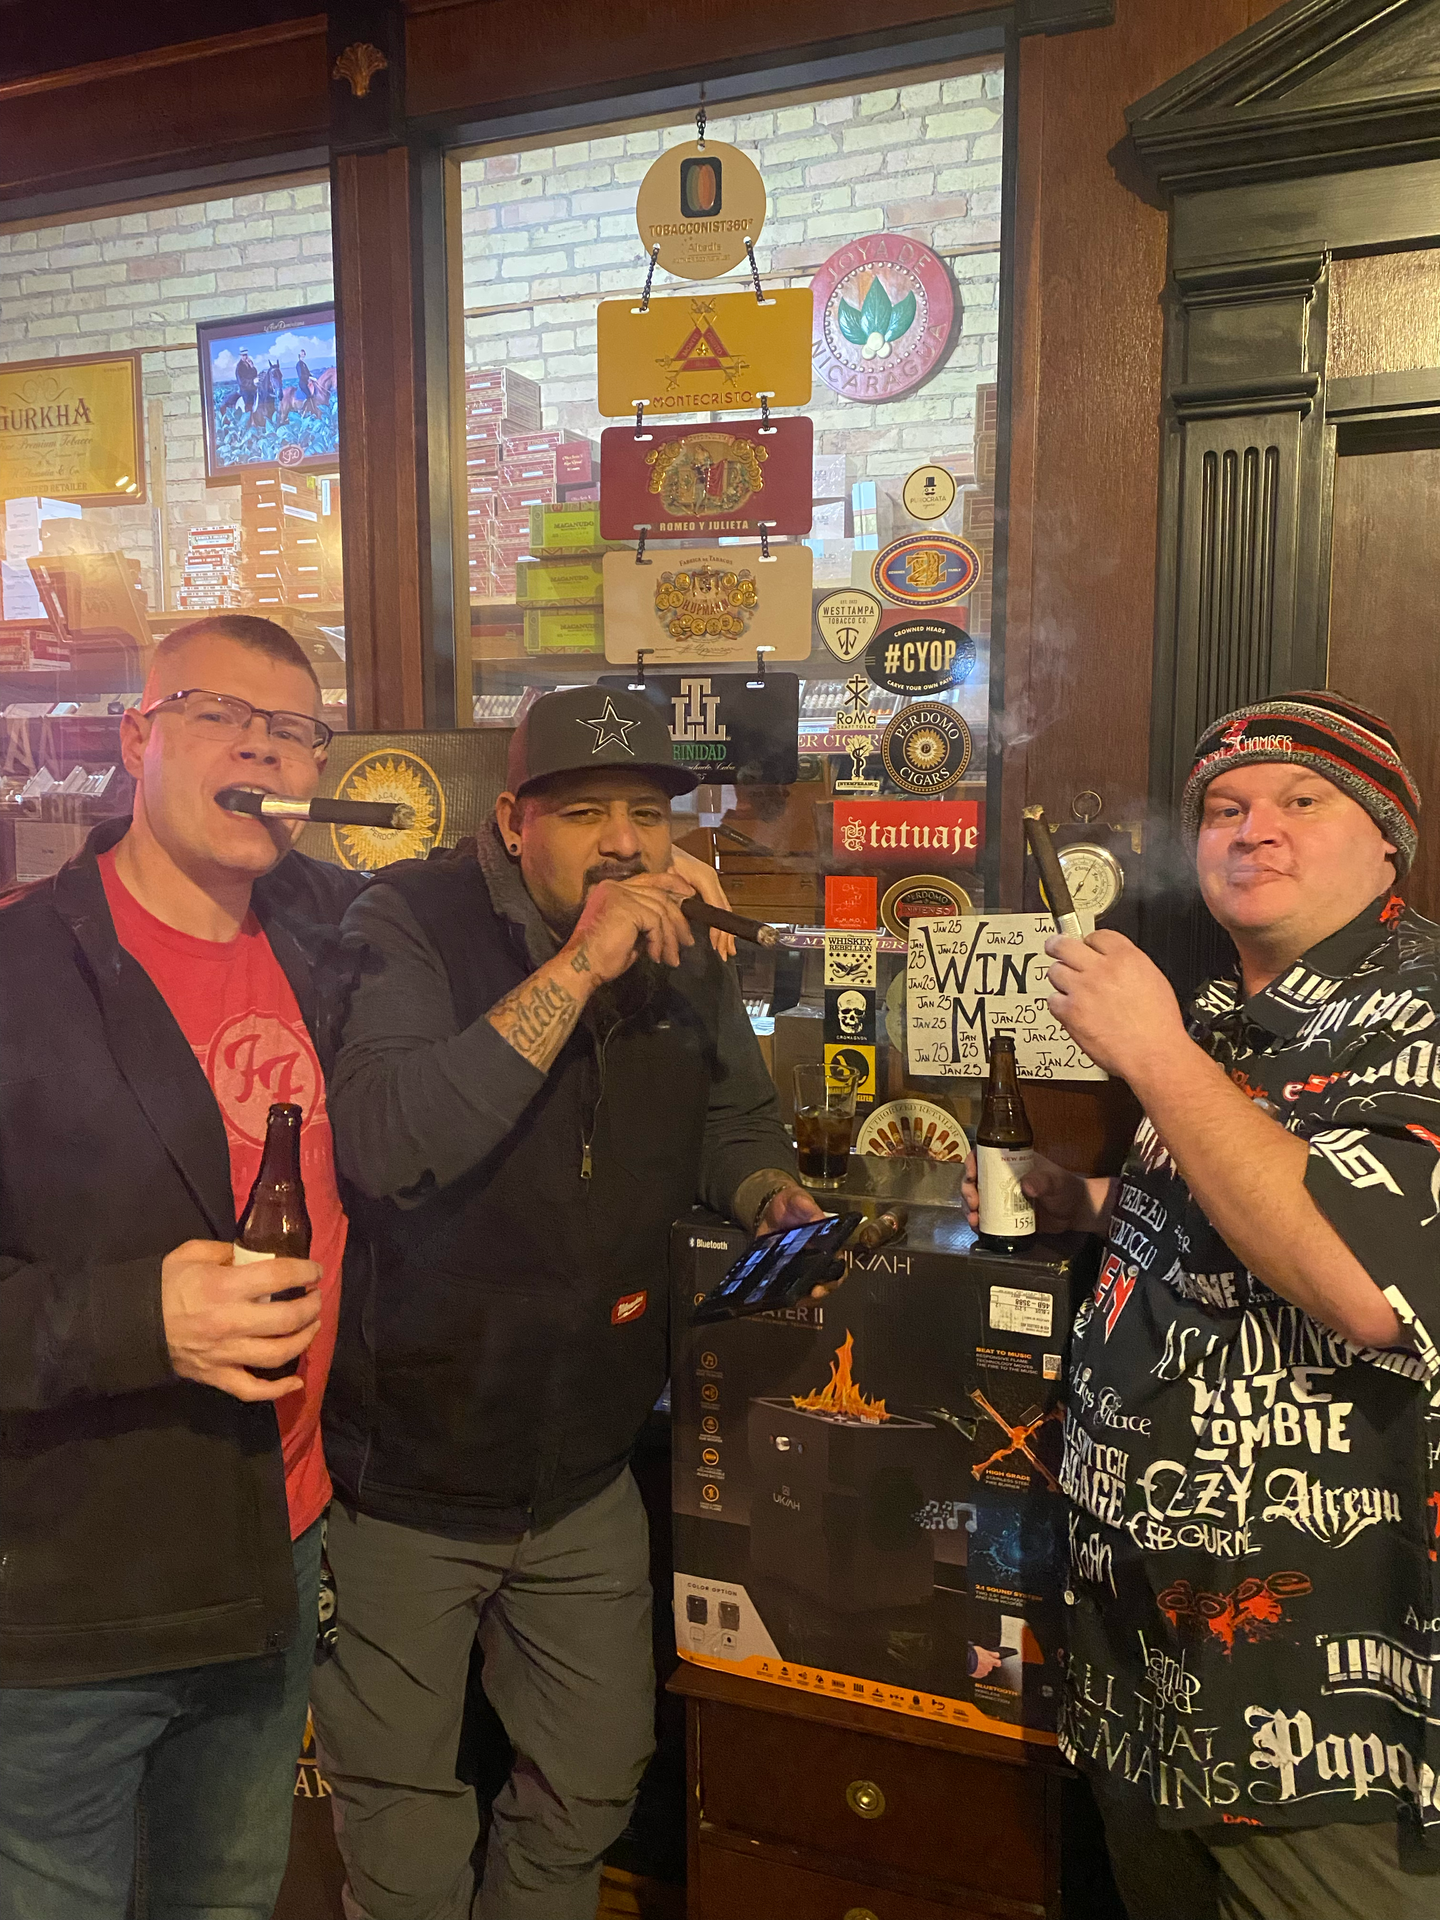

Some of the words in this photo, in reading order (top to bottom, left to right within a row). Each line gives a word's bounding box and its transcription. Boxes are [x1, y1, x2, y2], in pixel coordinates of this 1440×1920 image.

[828, 240, 889, 286] JOYA
[896, 242, 933, 275] DE
[653, 390, 752, 408] MONTECRISTO
[660, 521, 695, 532] ROMEO
[699, 521, 705, 531] Y
[708, 520, 749, 531] JULIETA
[823, 606, 847, 616] WEST
[848, 605, 874, 615] TAMPA
[828, 617, 856, 625] TOBACCO
[893, 626, 924, 638] CROWNED
[926, 625, 946, 634] HEADS
[884, 640, 956, 674] #CYOP
[887, 679, 905, 691] CARVE
[837, 711, 876, 725] RoMa
[895, 711, 960, 740] PERDOMO
[673, 744, 727, 760] RINIDAD
[900, 766, 951, 786] CIGARS
[948, 920, 962, 933] 25
[828, 937, 873, 946] WHISKEY
[1008, 931, 1024, 945] 25
[829, 944, 873, 952] REBELLION
[952, 941, 968, 954] 25
[908, 951, 926, 970] 25
[918, 922, 1038, 996] WIN
[922, 975, 936, 989] 25
[936, 995, 952, 1010] 25
[1014, 1005, 1036, 1024] 25
[931, 1018, 947, 1029] 25
[931, 1042, 949, 1062] 25
[962, 1043, 978, 1058] 25
[963, 1064, 982, 1076] 25
[1034, 1065, 1053, 1078] 25
[867, 1105, 917, 1136] AUTHORIZED
[919, 1105, 960, 1137] RETAILER
[697, 1238, 728, 1250] Bluetooth
[1008, 1352, 1032, 1360] MUSIC
[1006, 1473, 1031, 1481] GRADE
[687, 1581, 709, 1592] COLOR
[712, 1587, 737, 1597] OPTION
[986, 1586, 1012, 1595] SOUND
